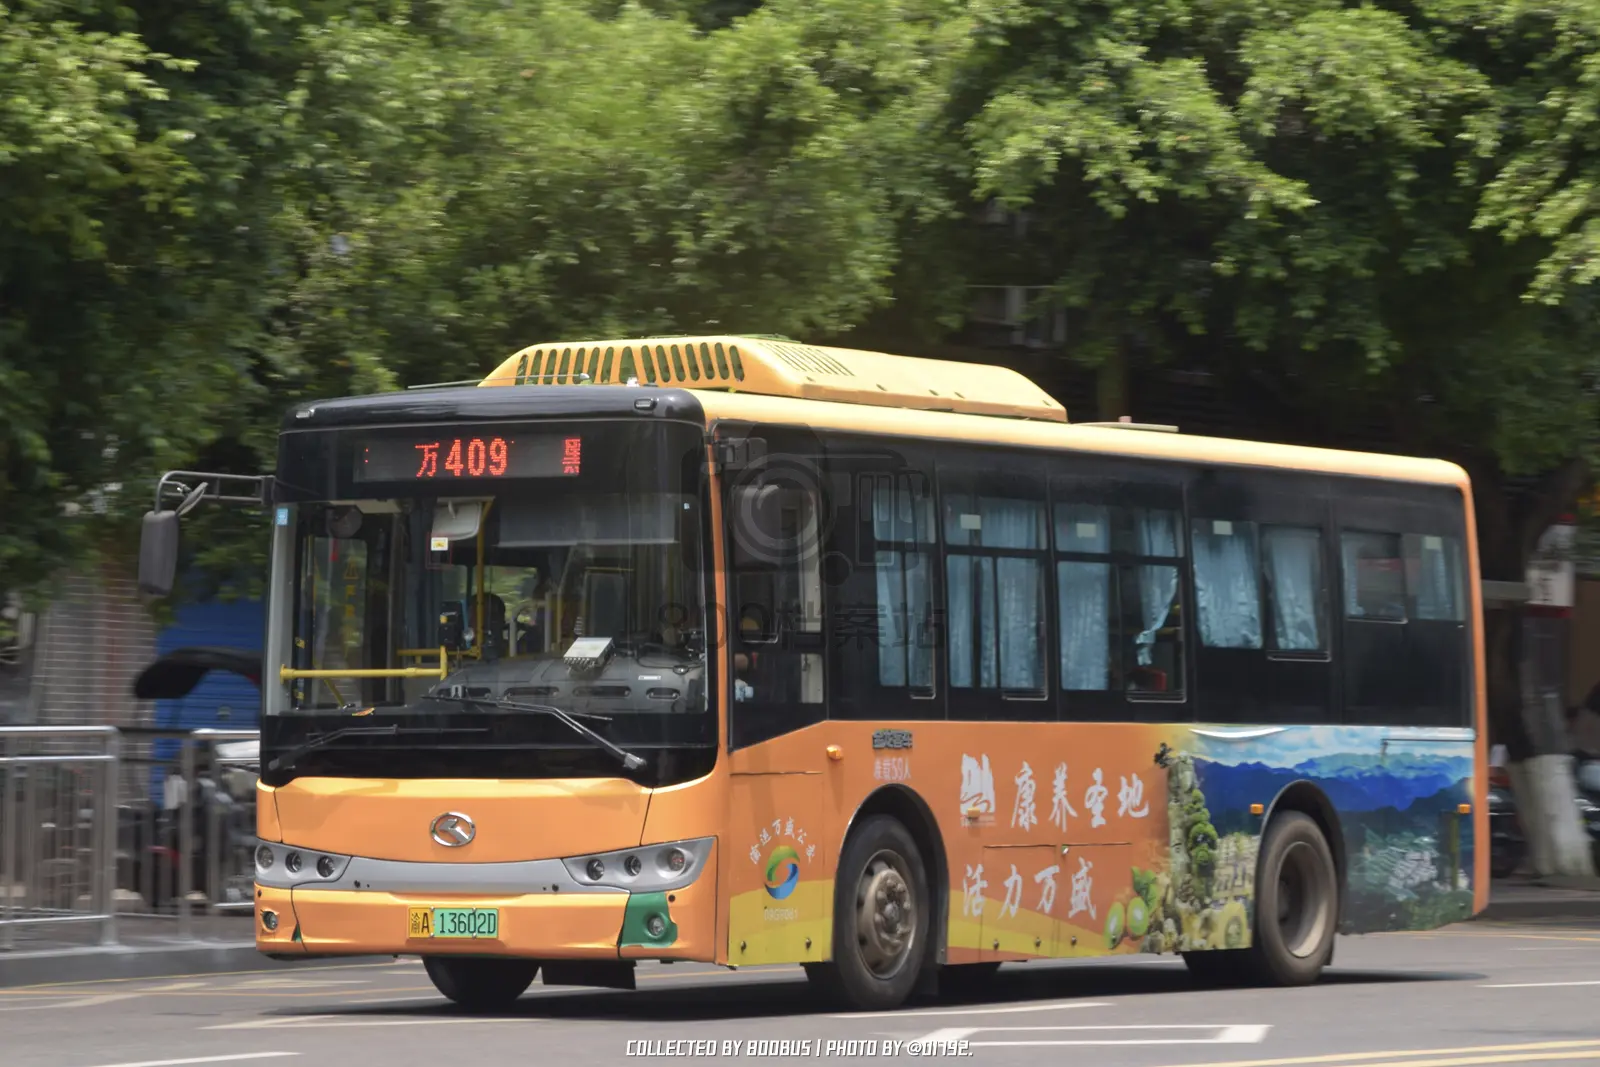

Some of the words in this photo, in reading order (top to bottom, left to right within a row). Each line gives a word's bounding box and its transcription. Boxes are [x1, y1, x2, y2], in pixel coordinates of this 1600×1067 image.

[414, 437, 508, 478] 万409
[1010, 760, 1149, 833] 康养圣地
[962, 856, 1097, 921] 活力万盛
